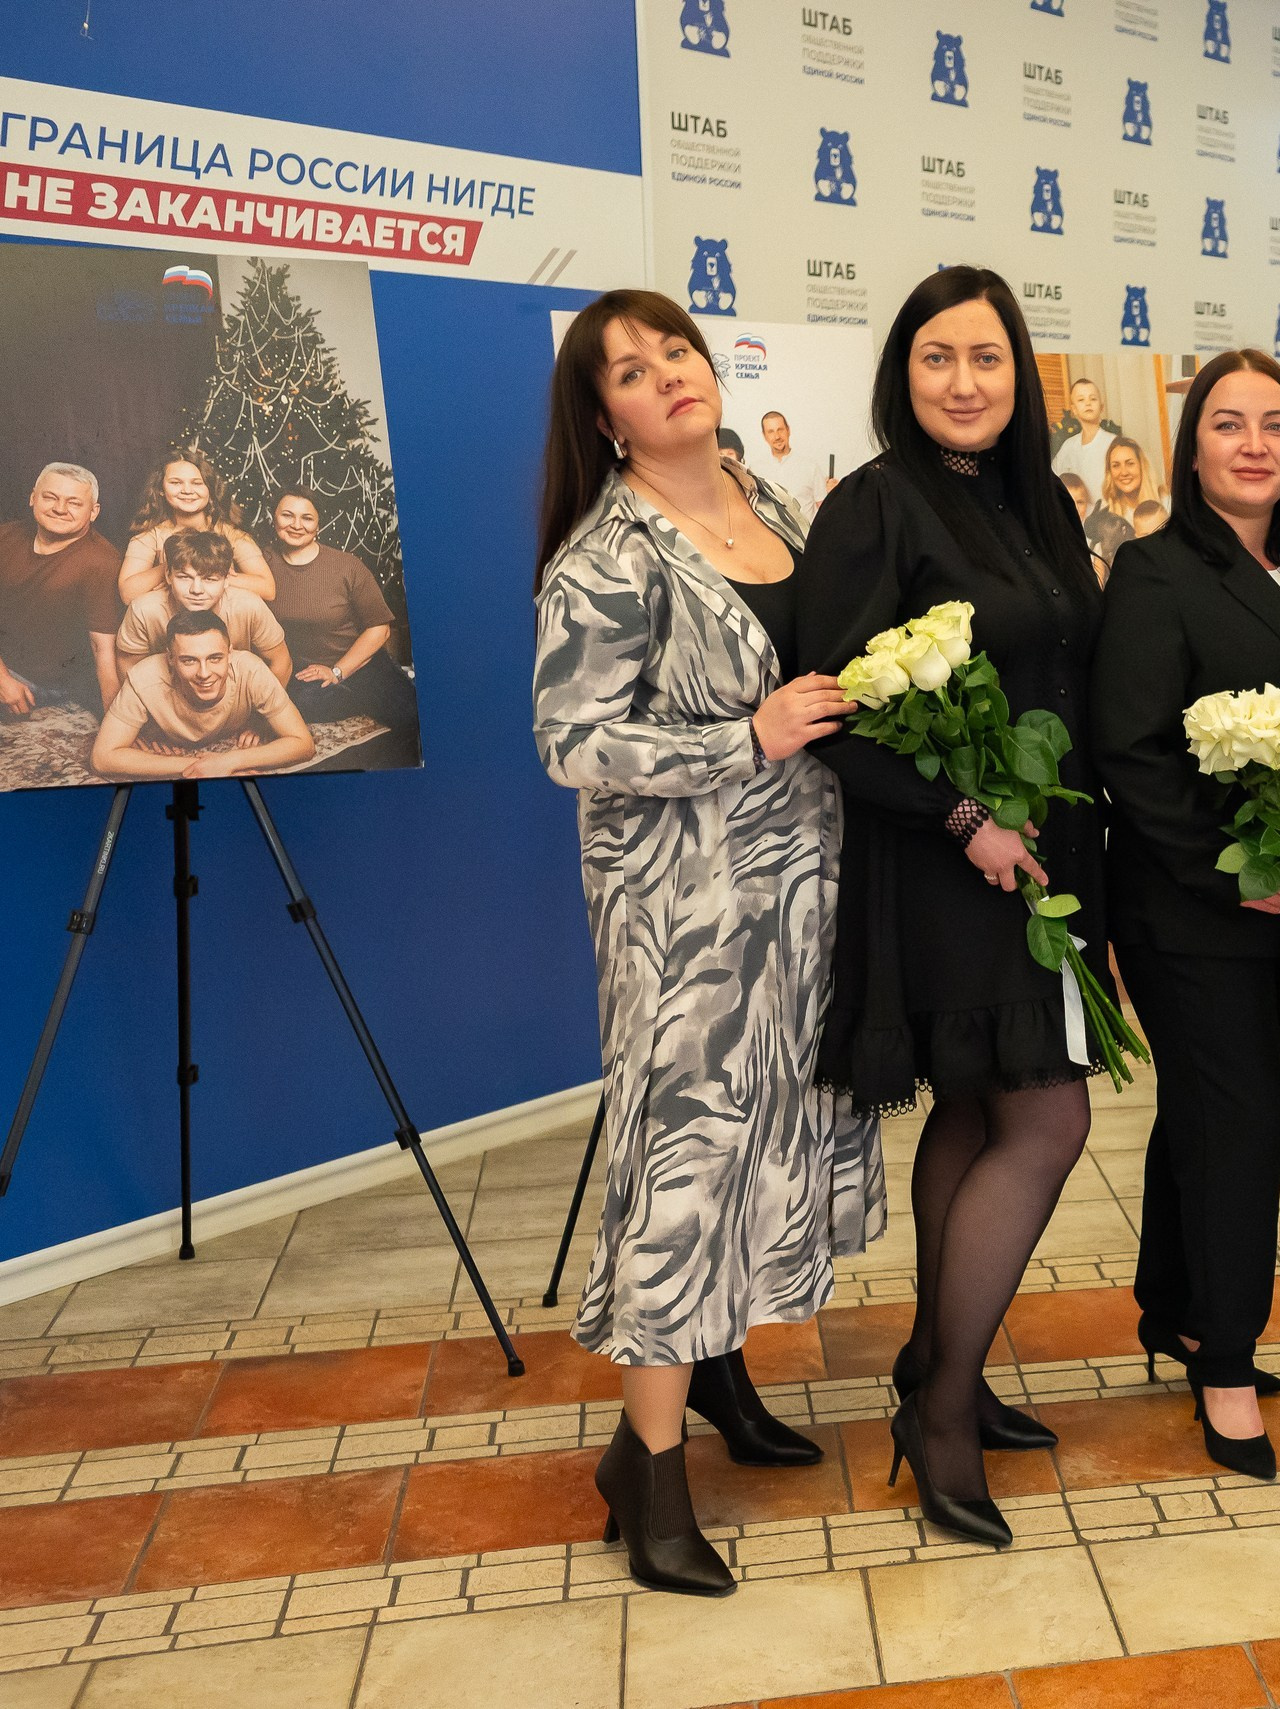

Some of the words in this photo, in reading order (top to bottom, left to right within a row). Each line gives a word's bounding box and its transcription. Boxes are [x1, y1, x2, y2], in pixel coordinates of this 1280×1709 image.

[802, 7, 853, 36] ШТАБ
[1023, 61, 1063, 85] ШТАБ
[671, 111, 728, 138] ШТАБ
[1196, 103, 1229, 125] ШТАБ
[0, 112, 233, 179] ГРАНИЦА
[248, 147, 415, 200] РОССИИ
[426, 173, 536, 220] НИГДЕ
[921, 155, 966, 178] ШТАБ
[1114, 188, 1149, 208] ШТАБ
[4, 171, 75, 215] НЕ
[87, 182, 466, 257] ЗАКАНЧИВАЕТСЯ
[807, 259, 856, 280] ШТАБ
[1023, 282, 1063, 300] ШТАБ
[1195, 301, 1226, 317] ШТАБ
[734, 353, 761, 362] ПРОЕКТ
[735, 363, 768, 371] КРЕПКАЯ
